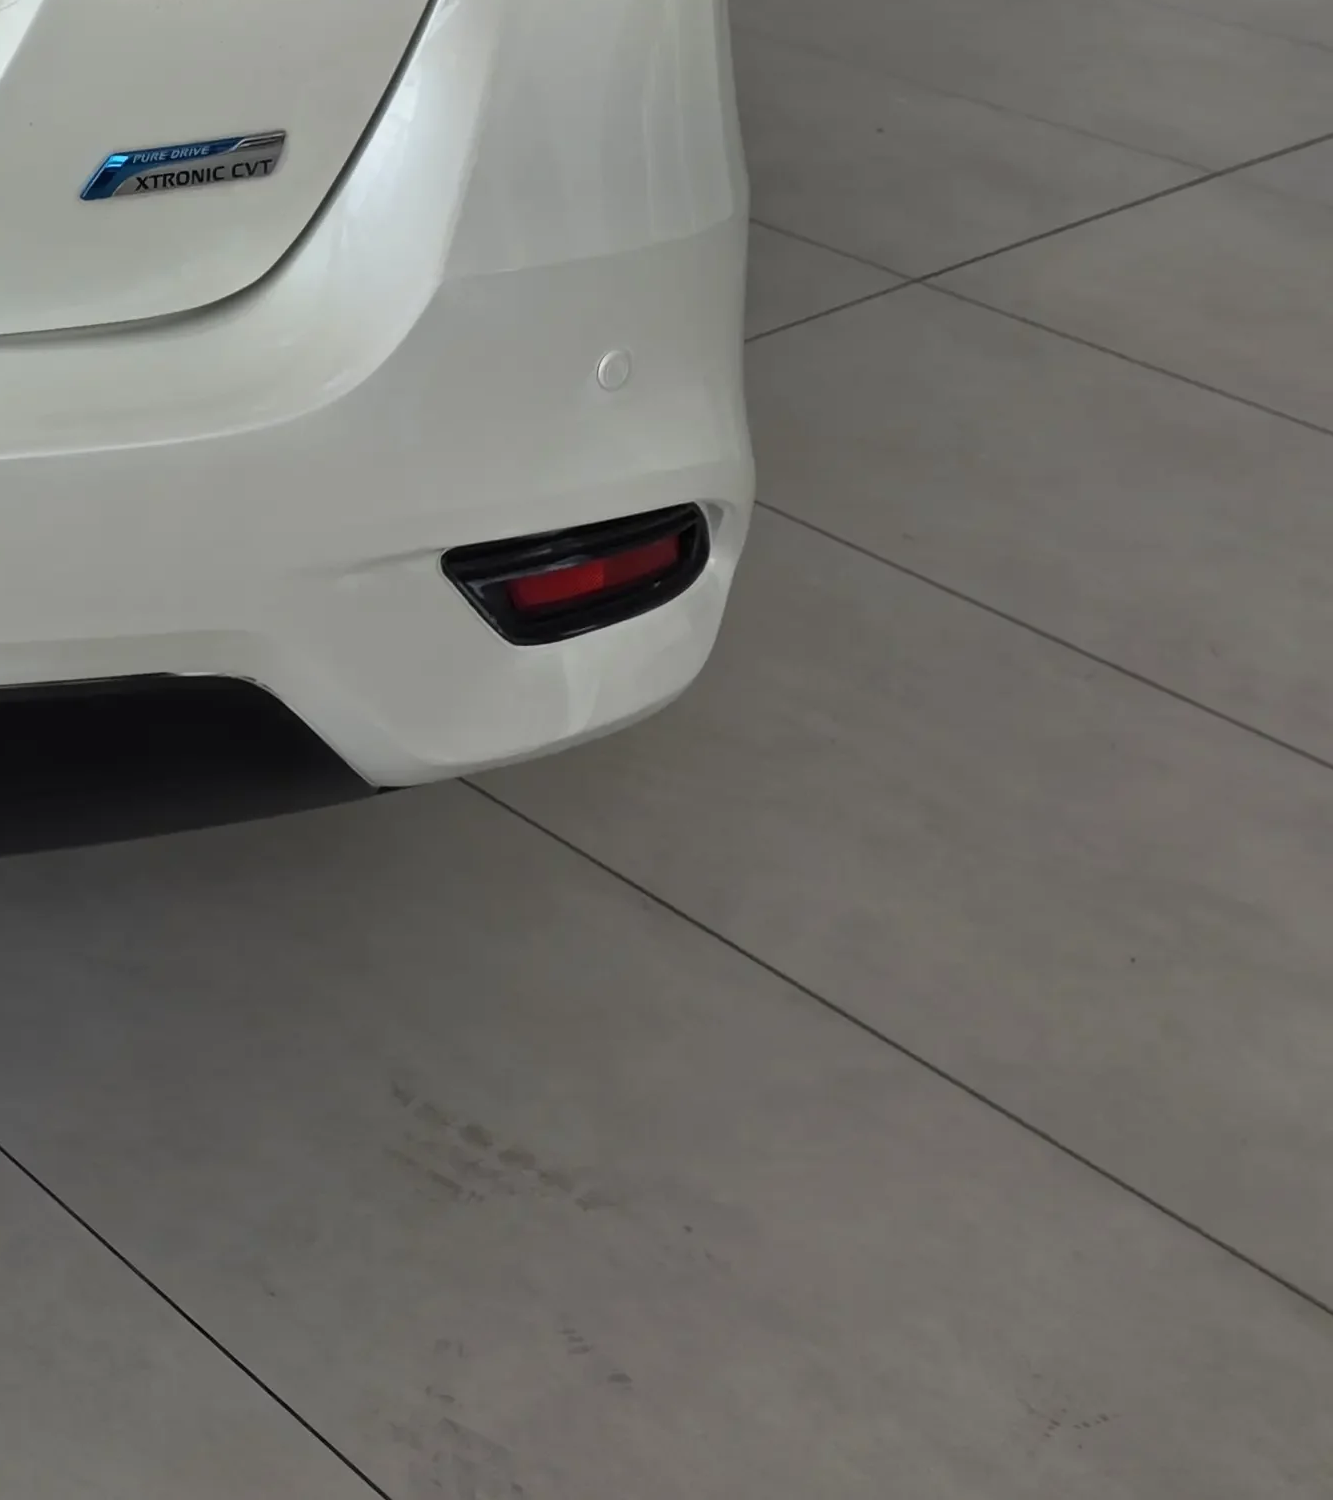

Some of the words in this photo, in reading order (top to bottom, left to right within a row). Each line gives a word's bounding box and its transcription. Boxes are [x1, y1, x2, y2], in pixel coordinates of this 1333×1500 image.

[133, 152, 168, 163] PURE
[171, 146, 210, 159] DRIVE
[135, 166, 225, 191] XTRONIC
[232, 159, 272, 178] CVT
